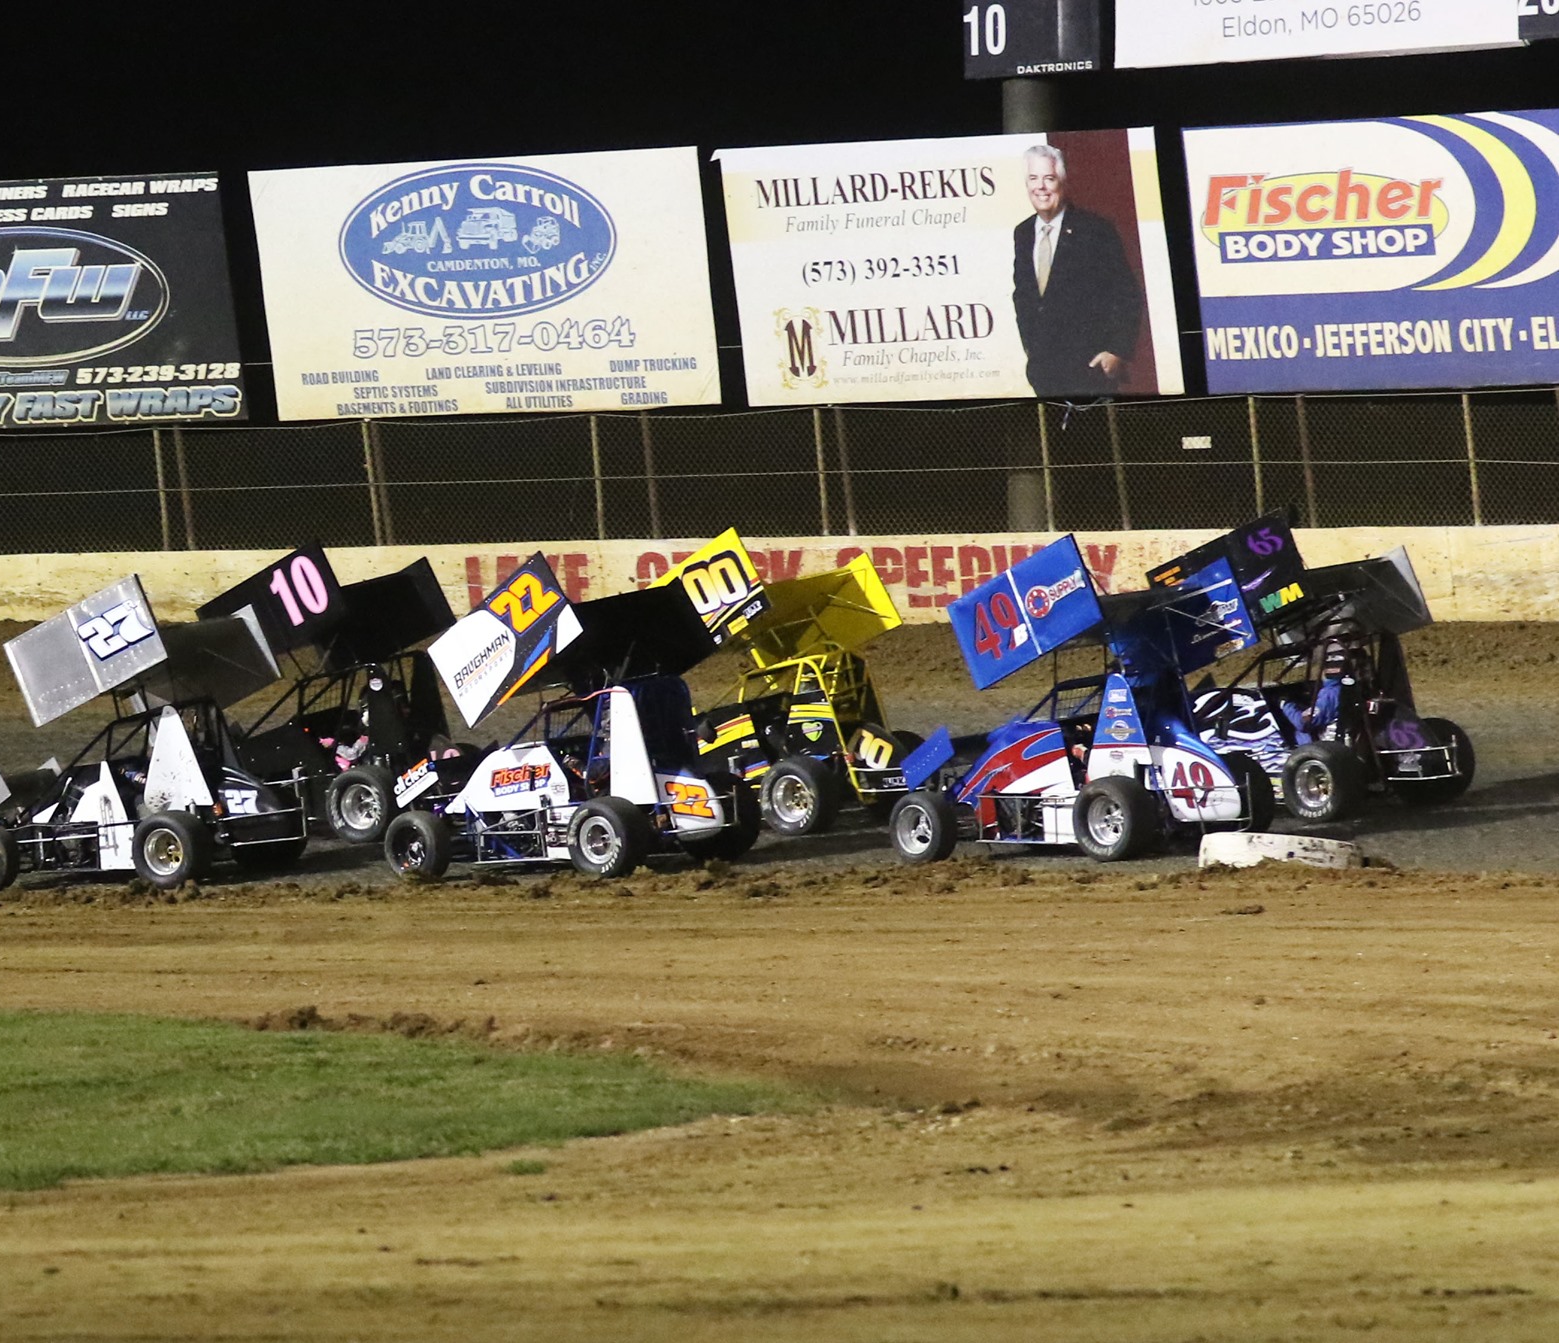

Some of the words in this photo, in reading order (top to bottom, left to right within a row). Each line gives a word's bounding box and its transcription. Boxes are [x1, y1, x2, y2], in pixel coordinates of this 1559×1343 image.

[963, 4, 1006, 56] 10
[1222, 15, 1292, 38] Eldon,
[1301, 8, 1338, 31] MO
[1347, 1, 1421, 26] 65026
[1017, 61, 1092, 74] DAKTRONICS
[62, 180, 145, 199] RACECAR
[149, 177, 217, 195] WRAPS
[755, 166, 996, 210] MILLARD-REKUS
[1203, 167, 1444, 228] Fischer
[31, 205, 93, 222] CARDS
[112, 202, 168, 218] SIGNS
[368, 180, 459, 239] Kenny
[469, 174, 581, 228] Carroll
[785, 214, 839, 234] Family
[844, 211, 905, 229] Funeral
[913, 206, 967, 229] Chapel
[1225, 232, 1324, 259] BODY
[1332, 229, 1428, 256] SHOP
[371, 251, 591, 309] EXCAVATING
[427, 258, 514, 273] CAMDENTON,
[517, 256, 541, 269] MO.
[802, 258, 856, 287] (573)
[864, 254, 960, 280] 392-3351
[352, 315, 635, 360] 573-317-0464
[826, 302, 994, 346] MILLARD
[1206, 325, 1298, 360] MEXICO
[1314, 320, 1452, 358] JEFFERSON
[1459, 318, 1513, 352] CITY
[426, 367, 451, 381] LAND
[454, 364, 503, 379] CLEARING
[506, 364, 514, 377] &
[516, 362, 562, 377] LEVELING
[609, 359, 639, 373] DUMP
[642, 357, 697, 372] TRUCKING
[843, 349, 894, 368] Family
[898, 345, 961, 366] Chapels,
[965, 347, 986, 362] Inc.
[76, 363, 240, 384] 573-239-3128
[301, 371, 329, 386] ROAD
[332, 369, 379, 384] BUILDING
[485, 379, 553, 395] SUBDIVISION
[556, 376, 647, 391] INFRASTRUCTURE
[13, 390, 103, 422] FAST
[105, 385, 241, 420] WRAPS
[337, 400, 397, 416] BASEMENTS
[399, 400, 407, 414] &
[408, 398, 458, 413] FOOTINGS
[354, 385, 389, 399] SEPTIC
[392, 383, 438, 398] SYSTEMS
[506, 397, 523, 410] ALL
[526, 395, 572, 409] UTILITIES
[621, 391, 668, 405] GRADING
[269, 555, 328, 627] 10
[682, 554, 749, 615] 00
[1048, 576, 1077, 600] SUPPLY
[1259, 582, 1304, 614] WM
[487, 571, 561, 634] 22
[77, 602, 155, 661] 27
[975, 592, 1020, 659] 49
[453, 630, 510, 689] BAUGHMAN
[458, 648, 513, 697] MOTORSPORTS
[490, 762, 551, 788] Fischer
[495, 784, 519, 796] BODY
[520, 778, 547, 793] SOP
[1171, 761, 1214, 808] 49
[224, 789, 260, 816] 27
[664, 781, 716, 819] 22
